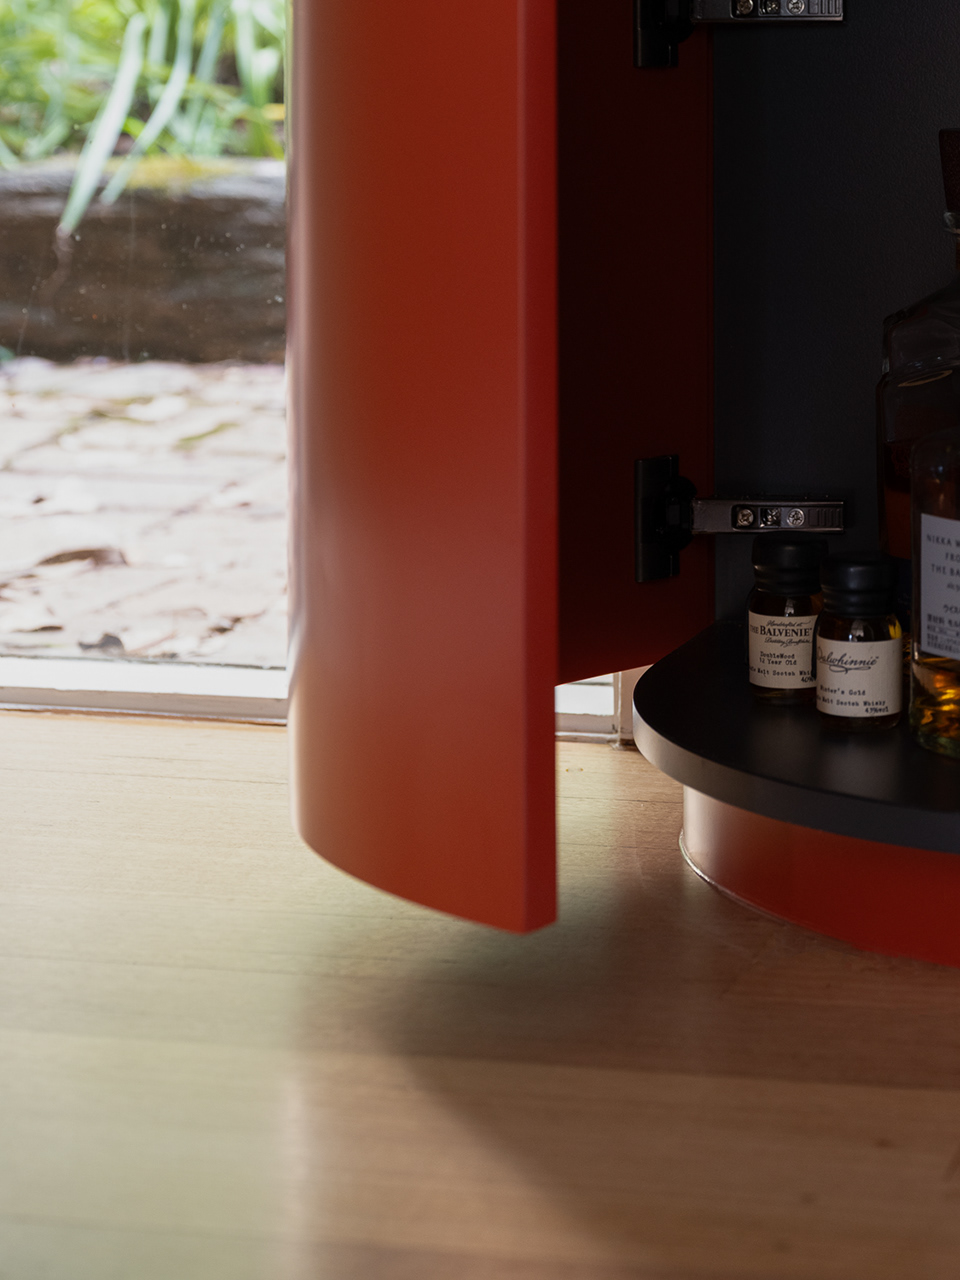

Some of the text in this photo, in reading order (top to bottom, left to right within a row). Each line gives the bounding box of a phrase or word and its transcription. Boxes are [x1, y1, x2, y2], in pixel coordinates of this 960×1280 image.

[926, 533, 952, 546] NIKKA
[931, 563, 946, 575] THE
[750, 625, 810, 637] THE BALVENIE
[760, 651, 795, 659] DoubleWood
